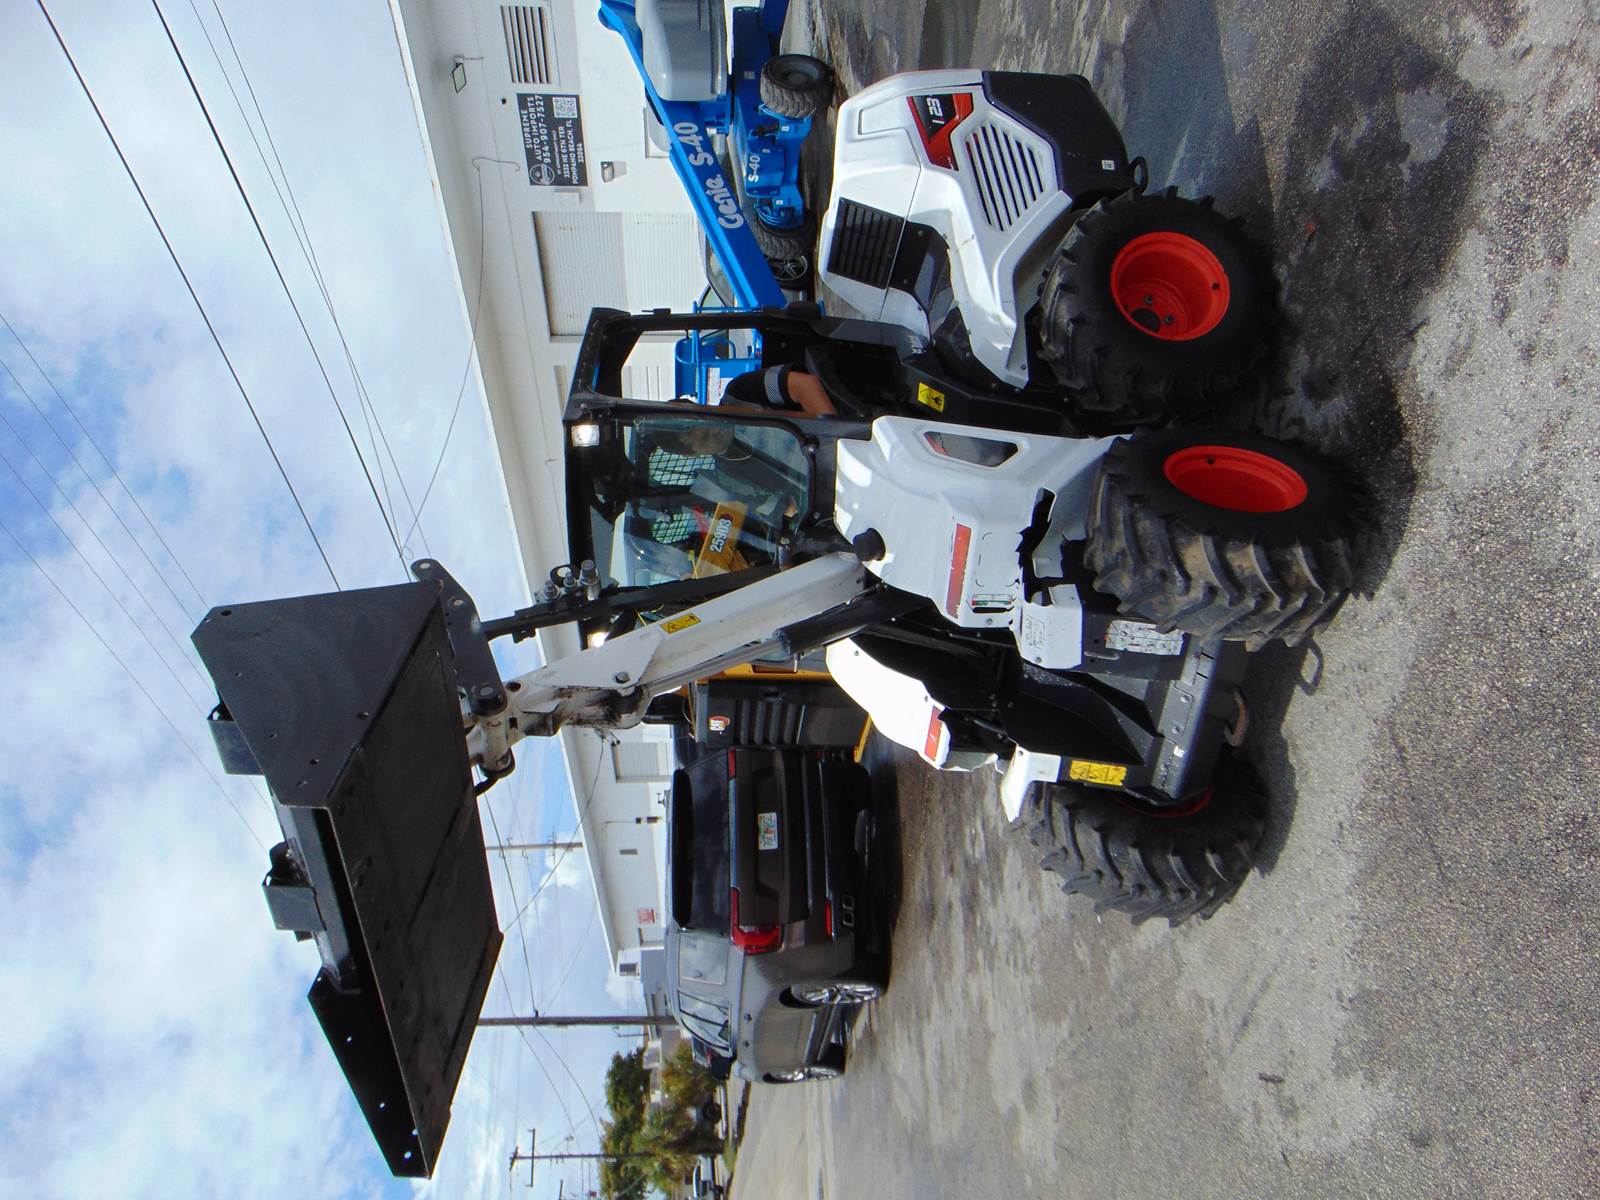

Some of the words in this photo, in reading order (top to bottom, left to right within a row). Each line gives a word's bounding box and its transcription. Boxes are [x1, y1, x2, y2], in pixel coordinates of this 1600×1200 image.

[521, 109, 532, 148] SUPREME
[527, 97, 538, 135] IMPORTS
[535, 95, 551, 163] 954-907-7527
[558, 126, 566, 138] TER
[533, 138, 542, 160] AUTO
[562, 154, 568, 162] NE
[673, 122, 714, 166] S-40
[570, 153, 578, 184] POMPANO
[748, 155, 760, 182] S-40
[706, 178, 744, 228] Genie
[709, 518, 732, 552] 259D3
